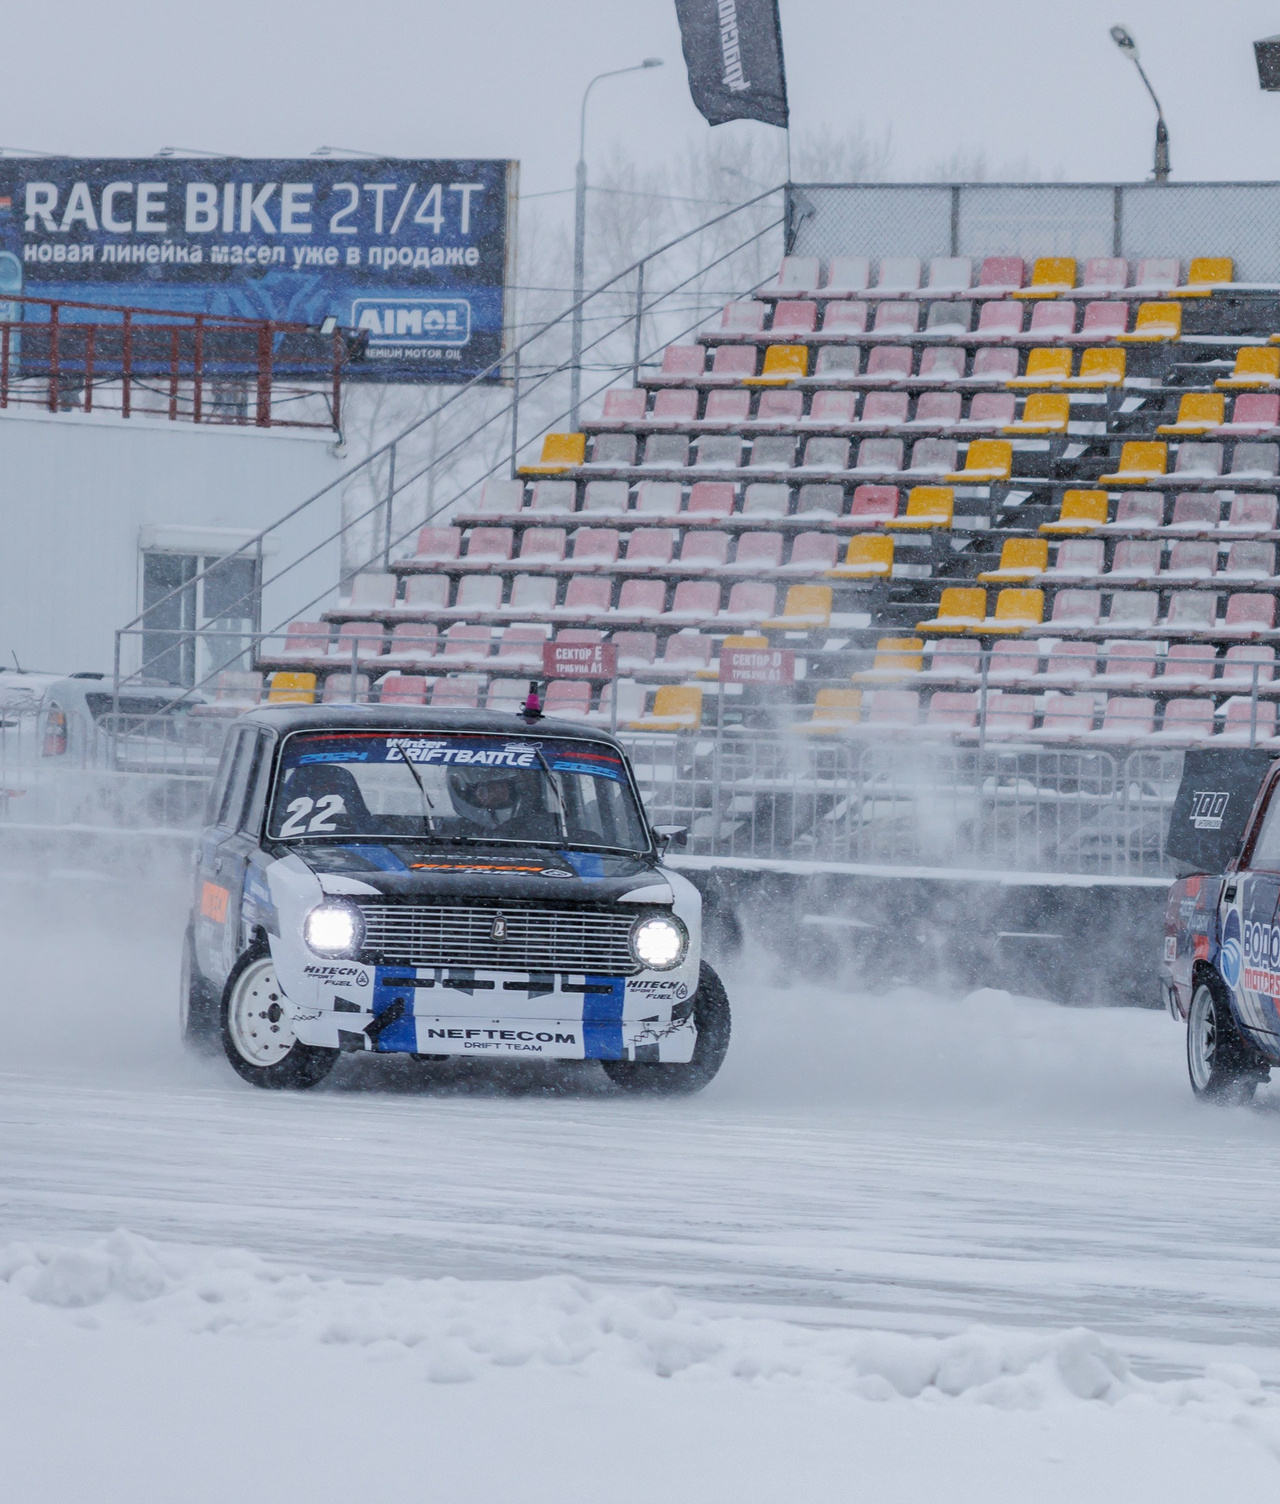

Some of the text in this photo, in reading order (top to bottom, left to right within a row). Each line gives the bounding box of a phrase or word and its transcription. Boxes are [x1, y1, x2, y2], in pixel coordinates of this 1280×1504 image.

[25, 182, 485, 234] RACE BIKE 2T/4T
[24, 240, 480, 270] новая линейка масел уже в продаже
[358, 309, 464, 335] AIMOL
[364, 348, 462, 360] REMIUM MOTOR OIL
[555, 647, 592, 660] СЕКТОР
[733, 653, 770, 666] СЕКТОР
[556, 664, 589, 673] ТРИБУНА
[733, 669, 767, 679] ТРИБУНА
[386, 738, 447, 749] Winter
[299, 752, 368, 765] 2024
[385, 747, 535, 767] DRIFTBATTLE
[553, 761, 618, 779] 2025
[1190, 791, 1230, 820] 100
[279, 794, 345, 838] 22
[626, 980, 680, 989] HITECH
[427, 1028, 576, 1045] NEFTECOM
[464, 1041, 543, 1052] DRIFT TEAM
